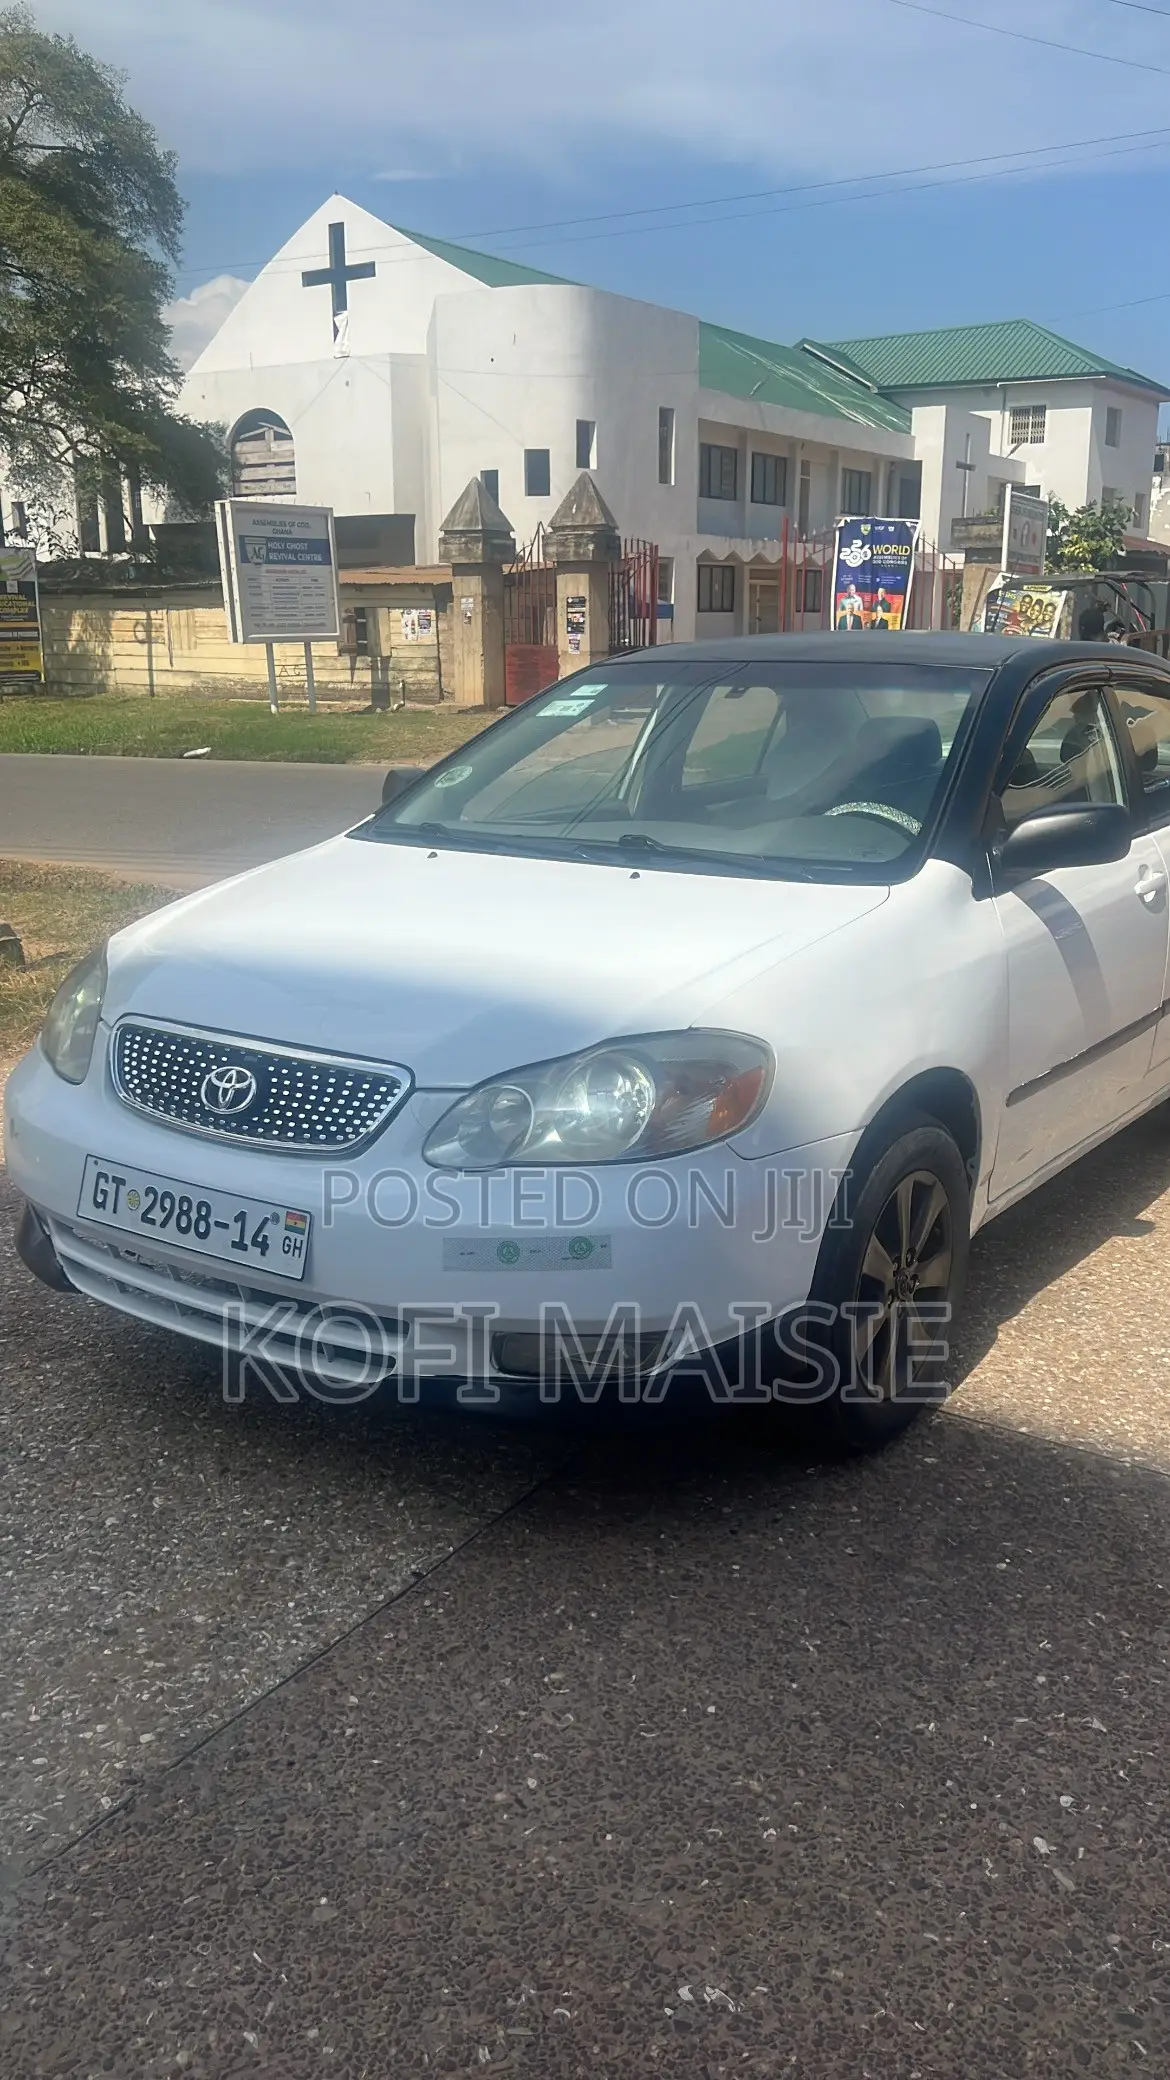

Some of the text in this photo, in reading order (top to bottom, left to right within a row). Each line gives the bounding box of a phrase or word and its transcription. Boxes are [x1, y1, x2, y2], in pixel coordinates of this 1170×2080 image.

[267, 541, 308, 551] HOLY GHOST
[872, 544, 911, 556] WORLD
[268, 552, 323, 562] REVIVAL CENTRE
[92, 1171, 270, 1257] GT 2988-14
[282, 1235, 304, 1259] GH
